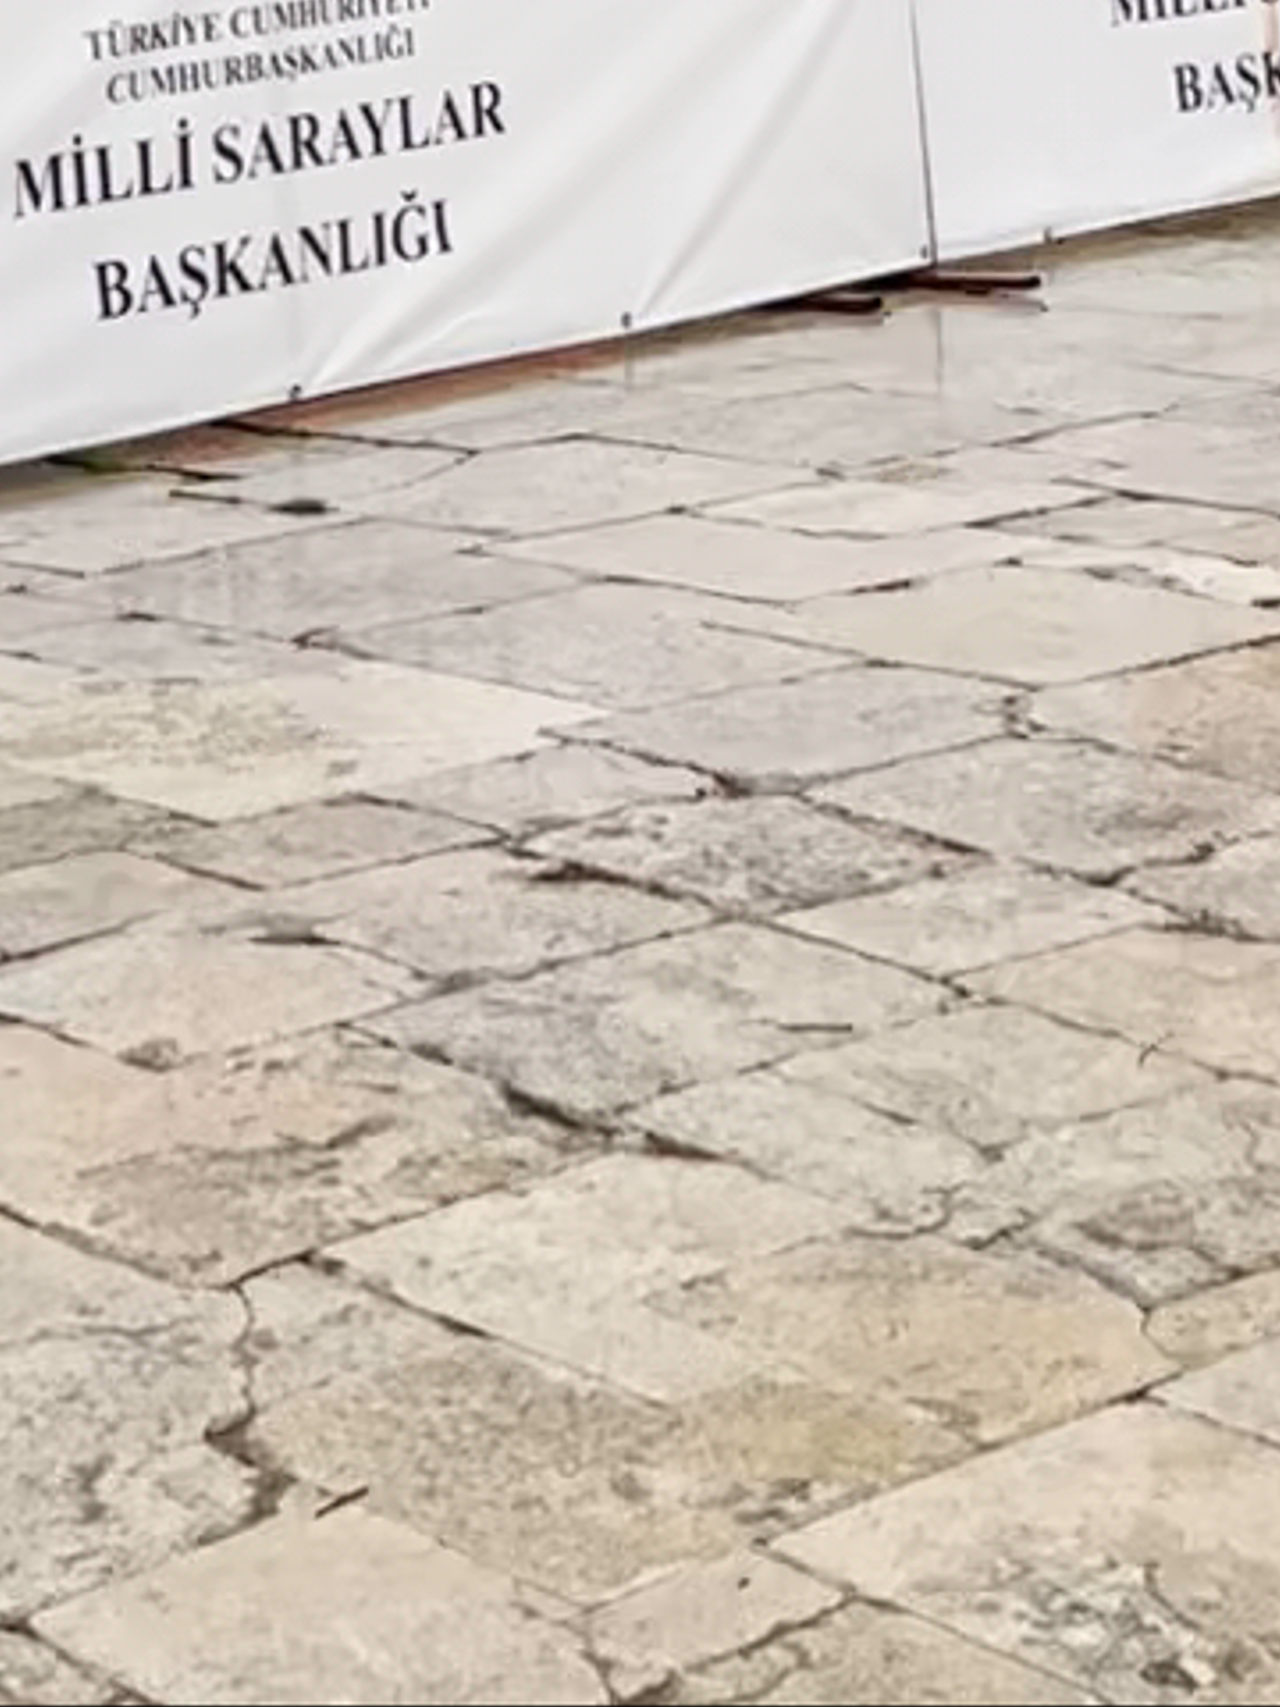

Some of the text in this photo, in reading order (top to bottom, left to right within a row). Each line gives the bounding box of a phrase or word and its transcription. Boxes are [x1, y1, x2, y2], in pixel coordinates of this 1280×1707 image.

[84, 12, 222, 61] TÜRKİYE
[106, 23, 415, 105] CUMHURBAŞKANLIĞI
[13, 80, 507, 220] MİLLİ SARAYLAR
[93, 188, 454, 322] BAŞKANLIĞI
